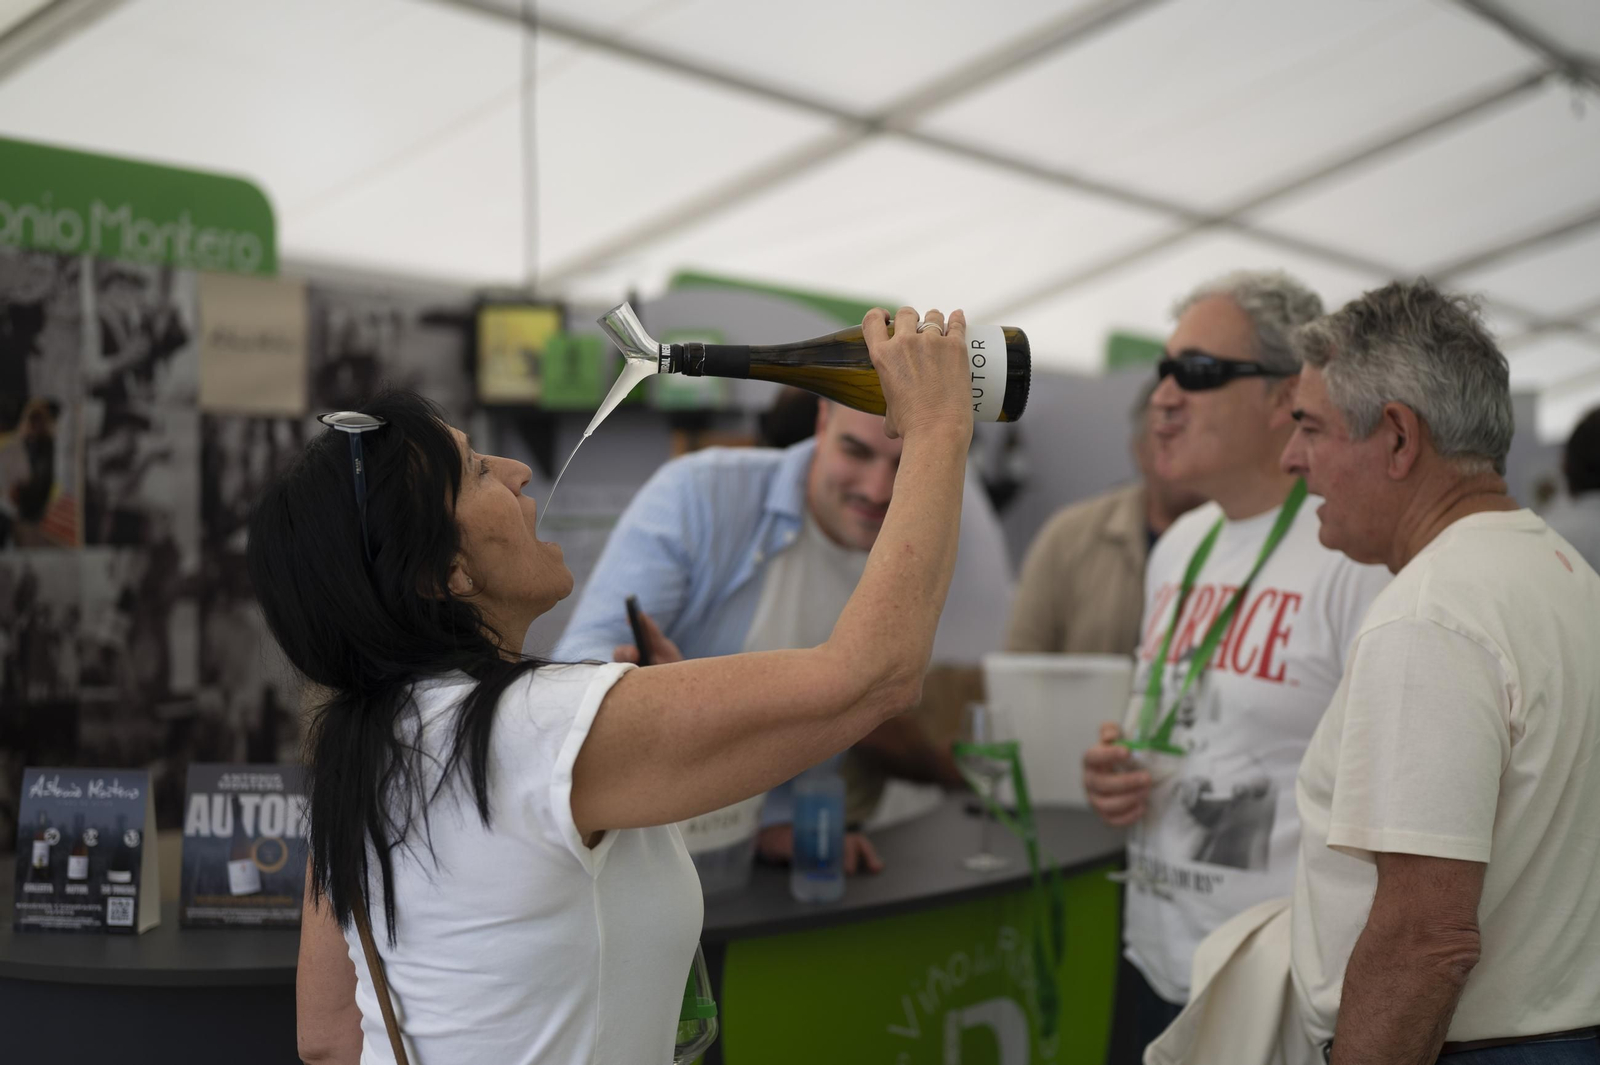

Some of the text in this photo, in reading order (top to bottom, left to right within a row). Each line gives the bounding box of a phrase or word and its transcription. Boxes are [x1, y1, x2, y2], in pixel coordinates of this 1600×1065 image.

[89, 198, 264, 270] Montero
[971, 339, 986, 413] AUTOR
[184, 793, 312, 839] AUTOR
